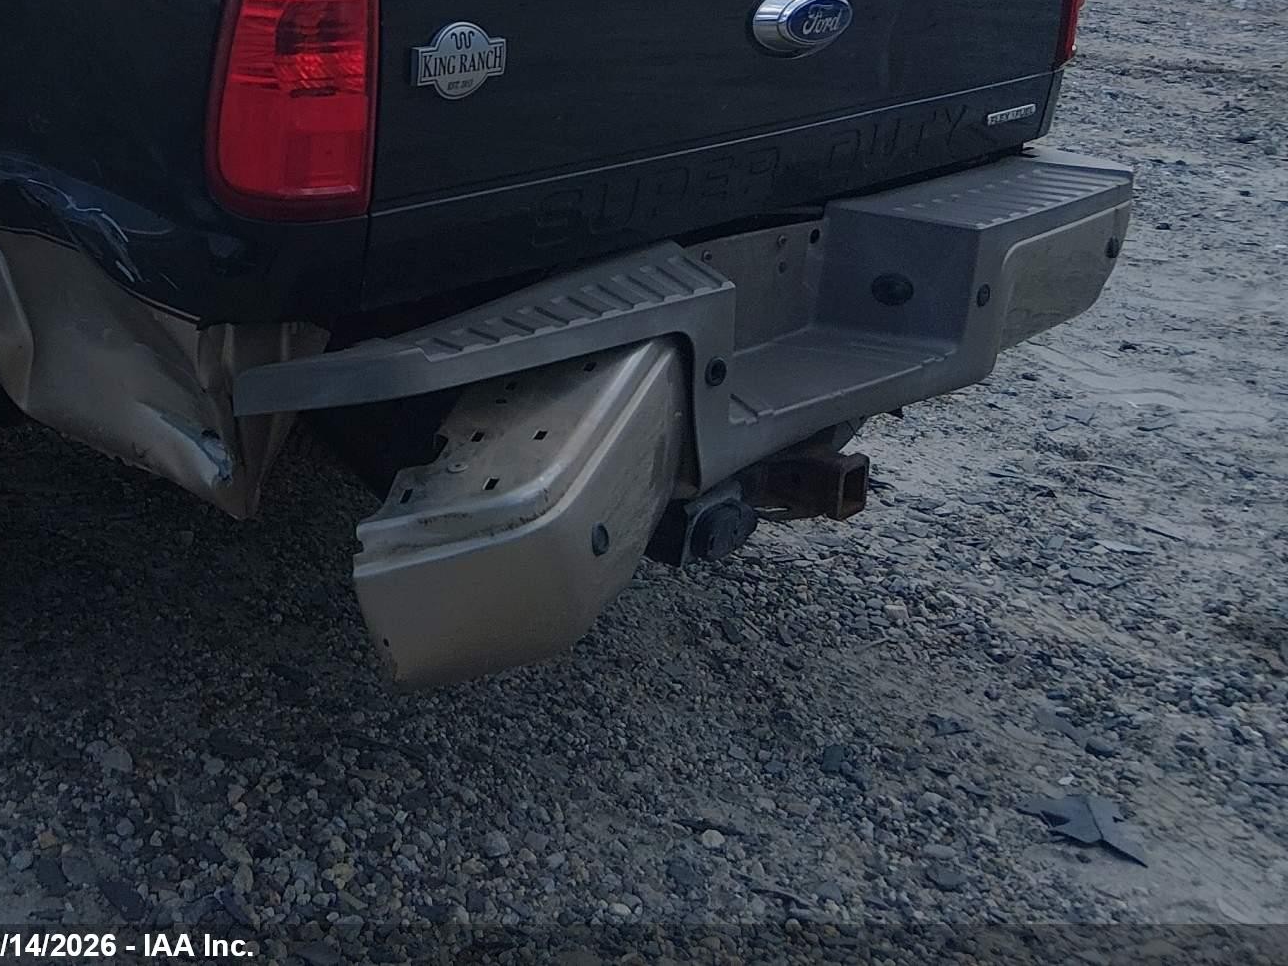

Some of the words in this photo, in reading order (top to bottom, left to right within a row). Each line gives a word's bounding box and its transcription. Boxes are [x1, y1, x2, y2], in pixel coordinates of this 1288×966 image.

[802, 3, 842, 35] Ford
[423, 54, 456, 78] KING
[459, 45, 502, 73] RANCH
[529, 145, 782, 247] SUPER
[826, 103, 968, 177] DUTY
